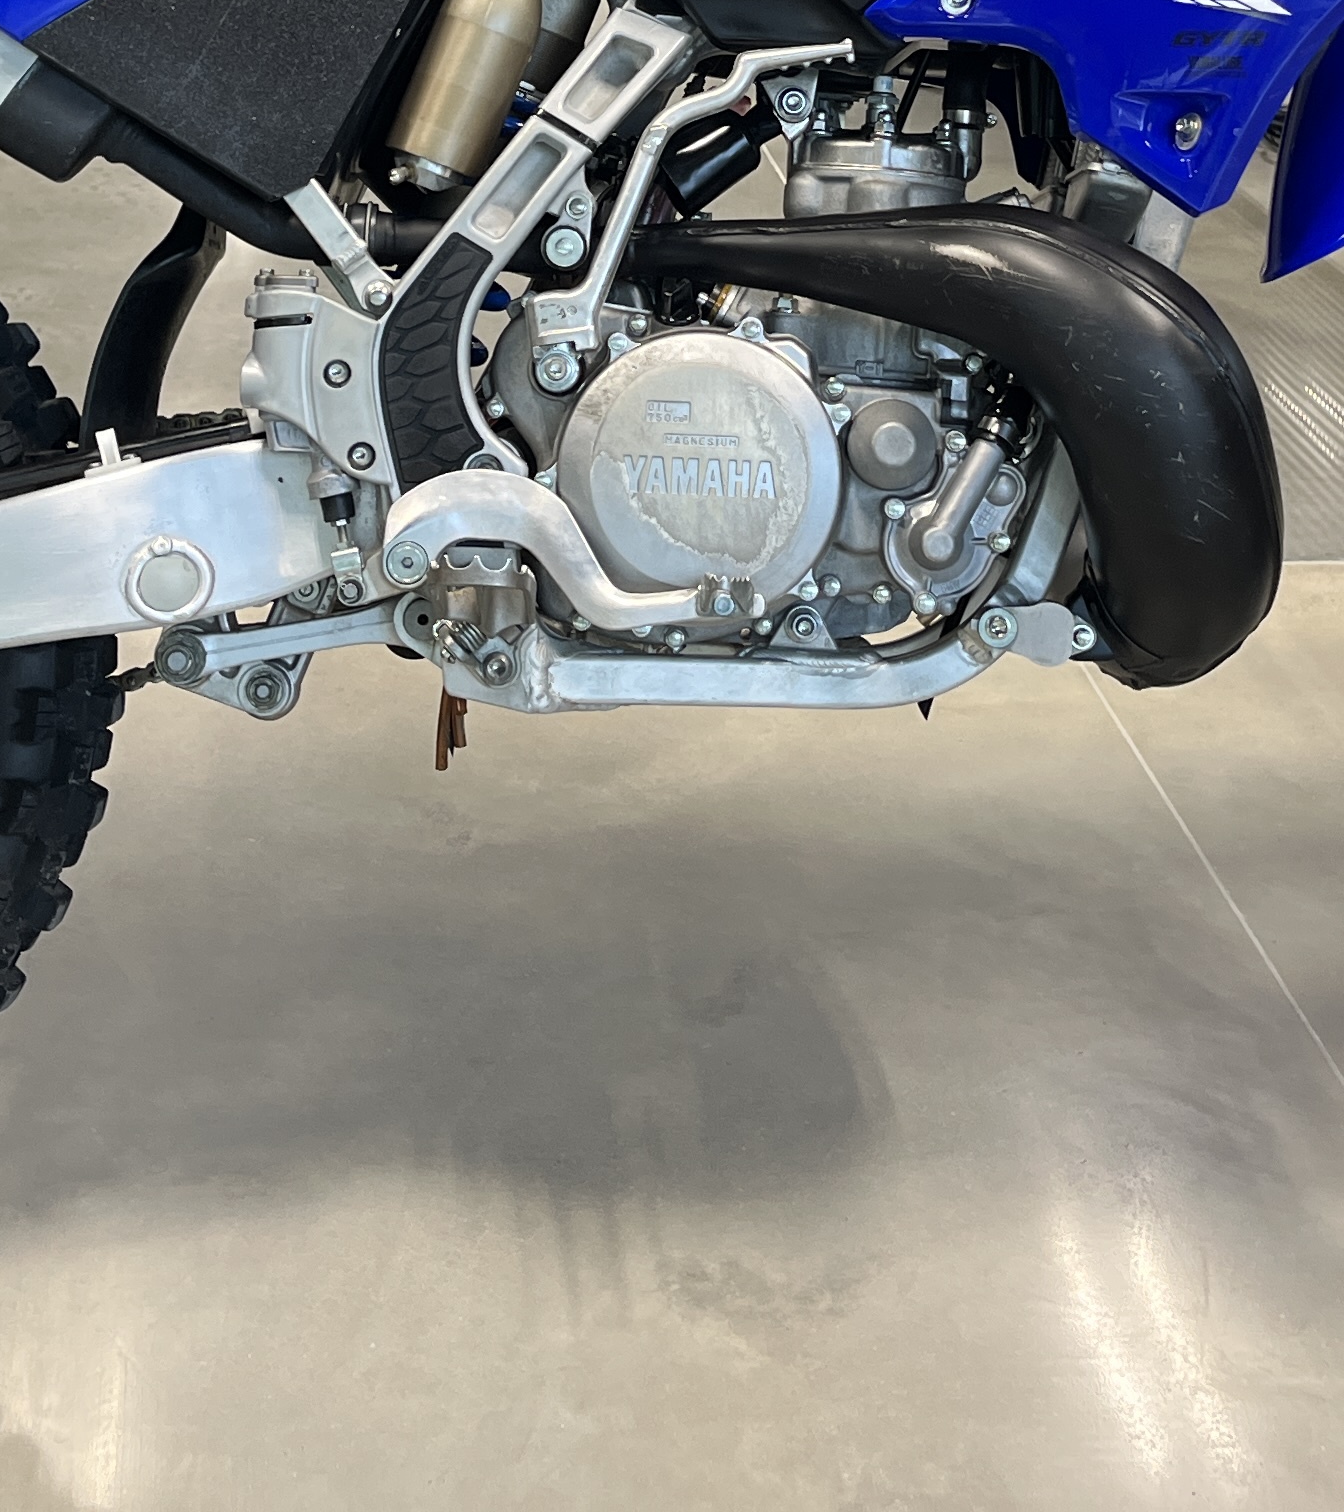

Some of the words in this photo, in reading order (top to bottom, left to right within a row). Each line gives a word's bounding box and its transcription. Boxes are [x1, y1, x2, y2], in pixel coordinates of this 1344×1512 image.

[647, 402, 673, 413] OIL
[664, 435, 738, 447] MAGNESIUM
[623, 454, 777, 499] YAMAHA
